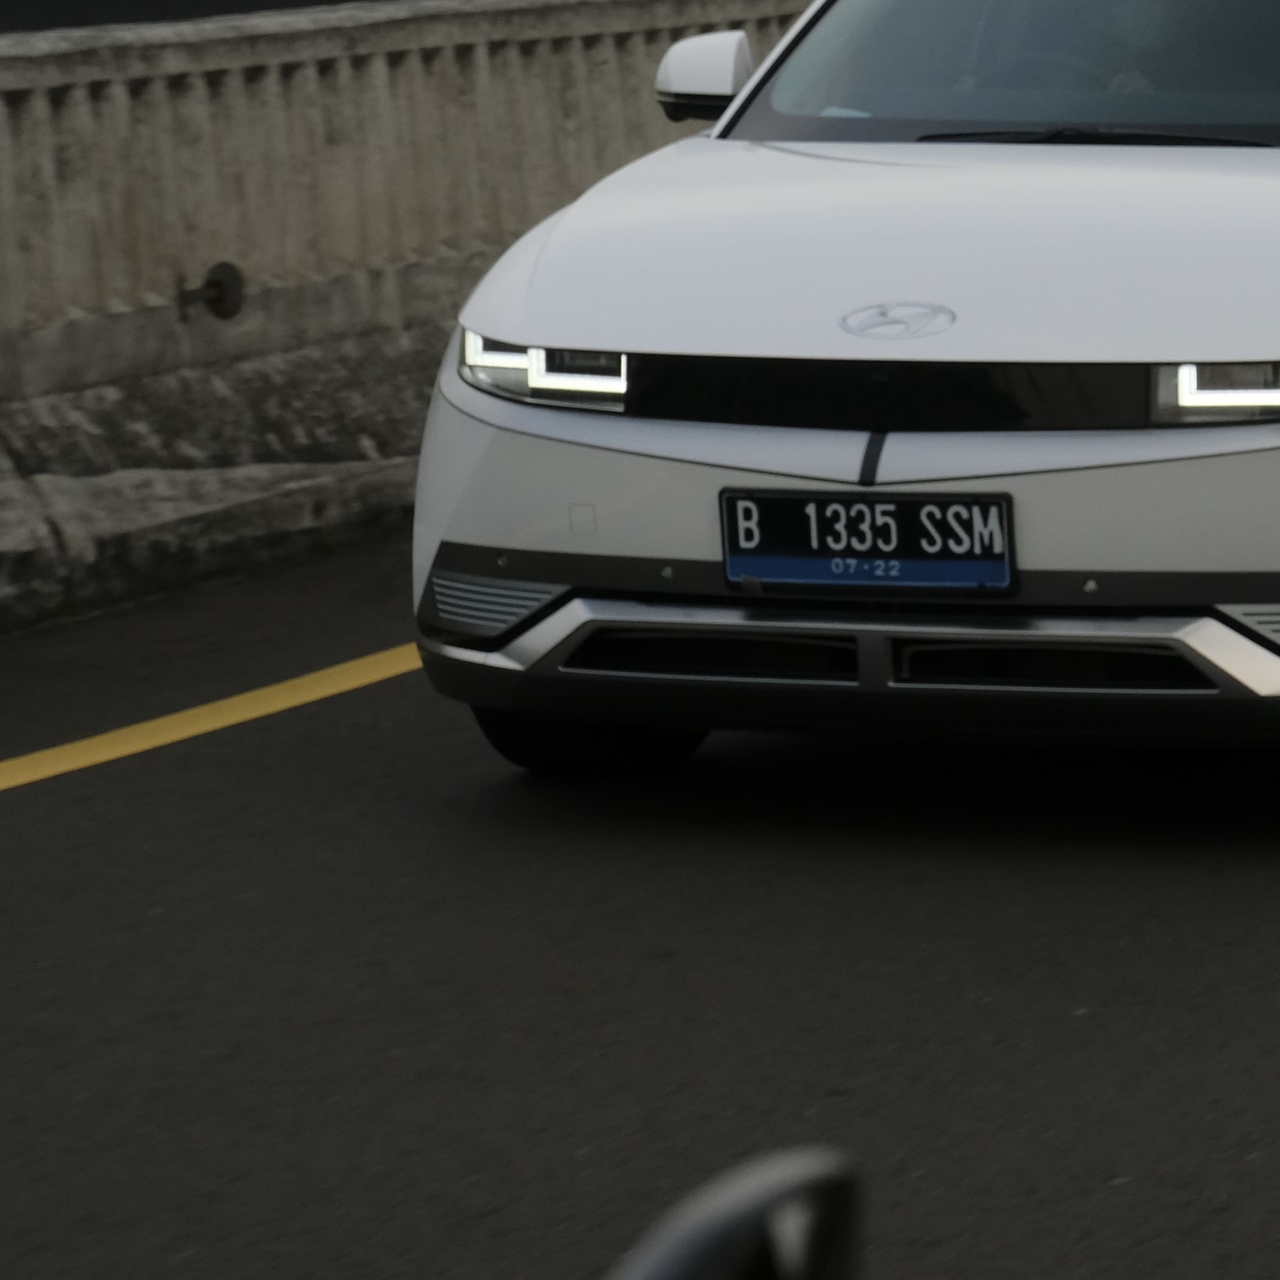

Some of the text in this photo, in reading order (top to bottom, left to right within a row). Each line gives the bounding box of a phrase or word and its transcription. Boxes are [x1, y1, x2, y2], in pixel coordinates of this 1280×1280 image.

[736, 500, 1004, 555] B 1335 SSM
